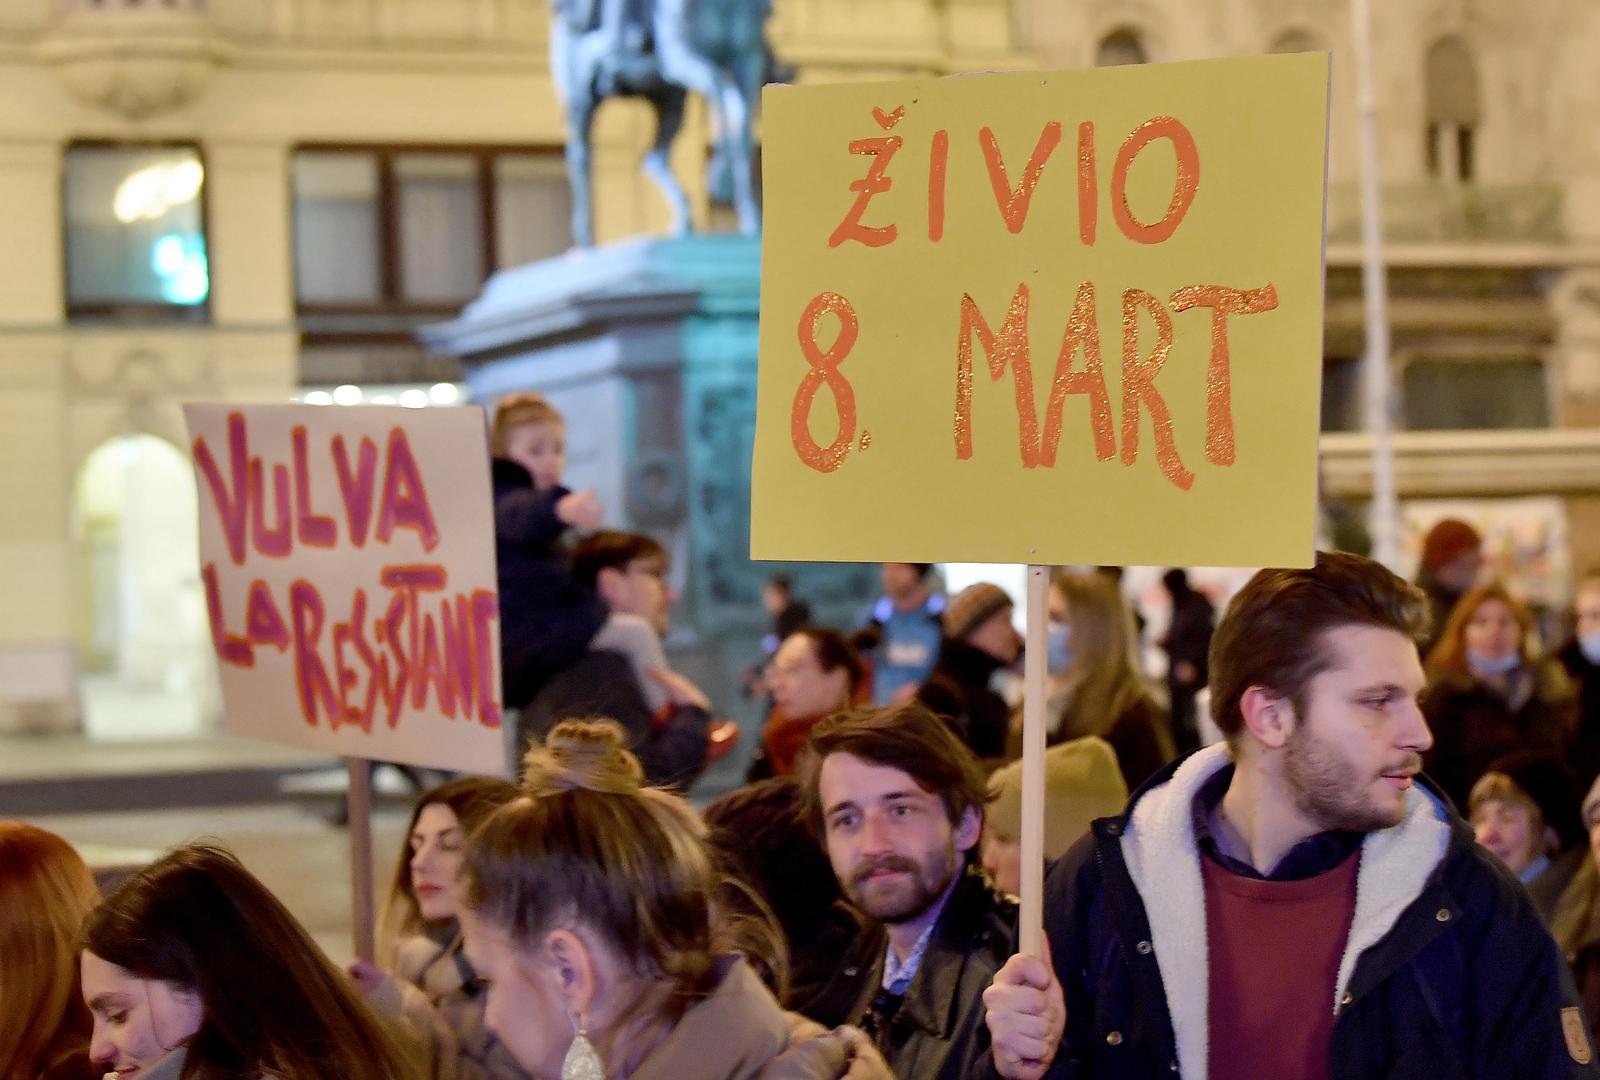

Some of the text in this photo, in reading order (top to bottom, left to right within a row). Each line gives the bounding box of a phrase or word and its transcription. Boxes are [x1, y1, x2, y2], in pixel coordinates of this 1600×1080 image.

[827, 104, 1202, 248] ŽIVIO
[790, 280, 1280, 492] 8. MART
[192, 410, 440, 566] VULVA
